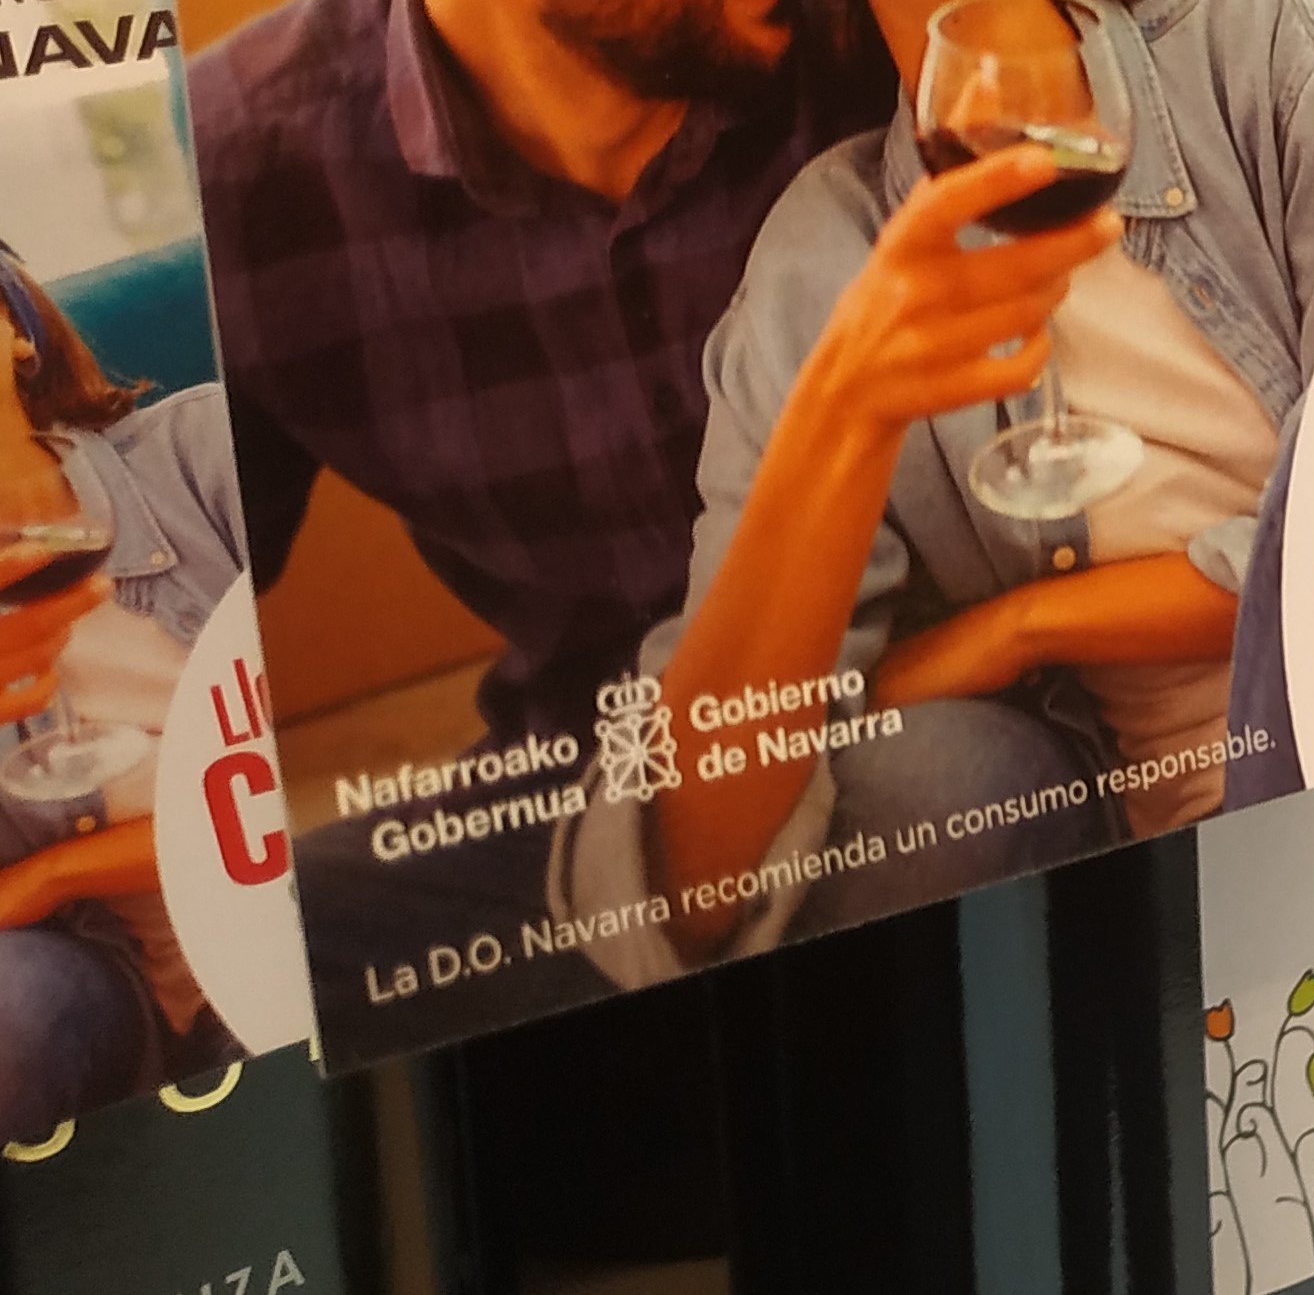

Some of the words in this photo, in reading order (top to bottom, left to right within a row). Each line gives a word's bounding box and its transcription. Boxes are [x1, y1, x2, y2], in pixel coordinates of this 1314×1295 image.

[689, 667, 866, 734] Gobierno
[335, 730, 580, 818] Nafarroako
[697, 741, 748, 783] de
[757, 704, 905, 769] Navarra
[370, 784, 588, 863] Gobernua
[365, 961, 419, 1007] La
[427, 936, 511, 987] D.O.
[521, 894, 672, 963] Navarra
[680, 832, 888, 917] recomienda
[896, 821, 938, 855] un
[945, 776, 1089, 843] consumo
[1095, 724, 1278, 804] responsable.
